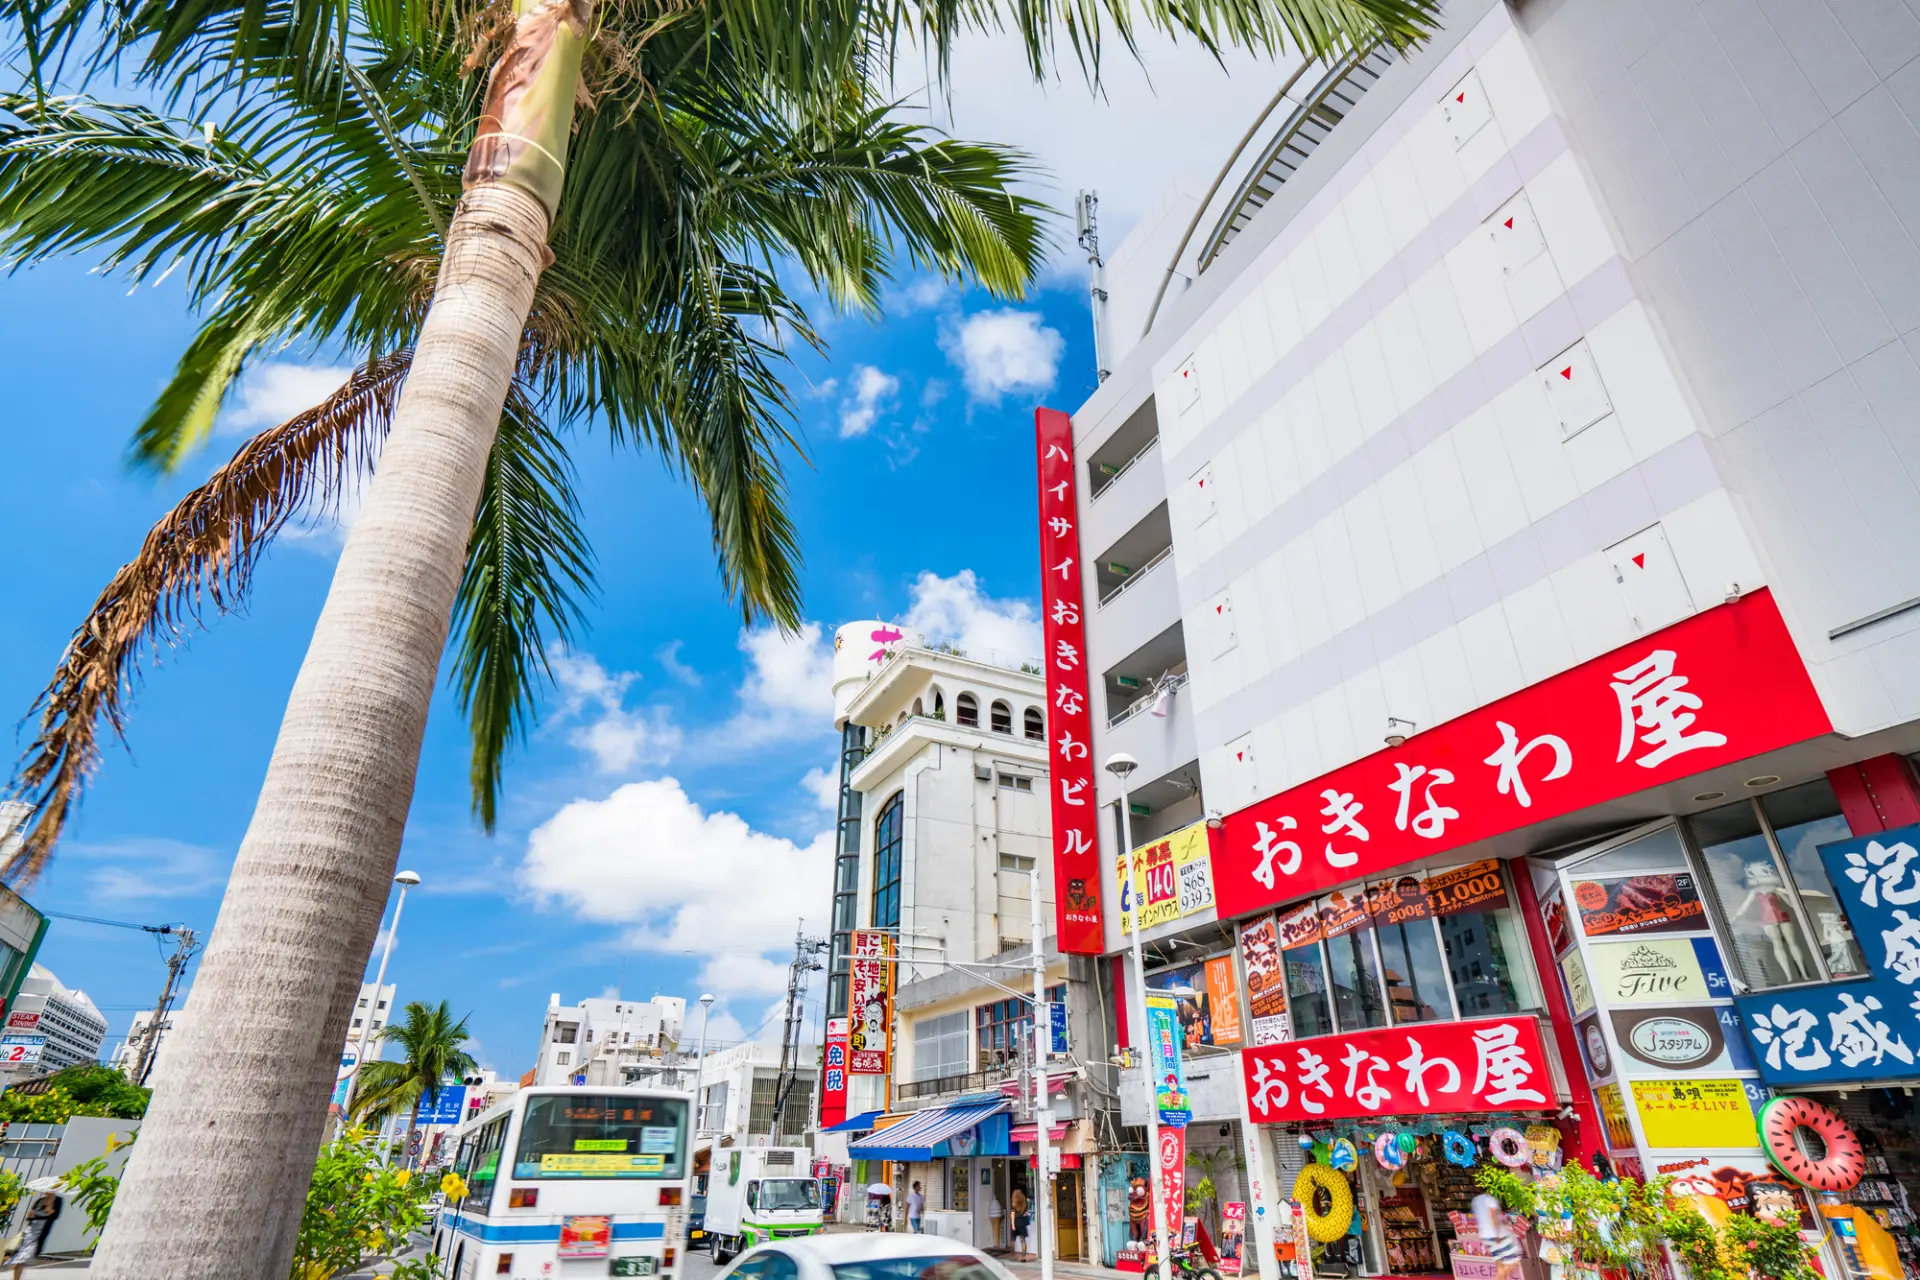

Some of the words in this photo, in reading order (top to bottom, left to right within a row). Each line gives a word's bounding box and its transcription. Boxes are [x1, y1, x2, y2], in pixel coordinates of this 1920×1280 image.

[1045, 444, 1093, 855] ハイサイおきなわビル
[1251, 649, 1728, 890] おきなわ屋
[1184, 870, 1206, 893] 868
[1676, 878, 1689, 887] 2F
[1181, 887, 1212, 911] 9393
[1066, 914, 1098, 923] おきなわ屋
[1388, 903, 1425, 923] 200g
[1617, 972, 1688, 998] Five
[1707, 972, 1727, 988] 5F
[12, 1012, 35, 1020] STEAK
[12, 1020, 36, 1028] DINING
[1720, 1010, 1741, 1027] 4F
[1159, 1015, 1176, 1071] 観光月間
[826, 1045, 844, 1091] 免税
[1251, 1023, 1547, 1116] おきなわ屋
[1744, 1083, 1767, 1102] 3F
[1703, 1101, 1739, 1111] LIVE
